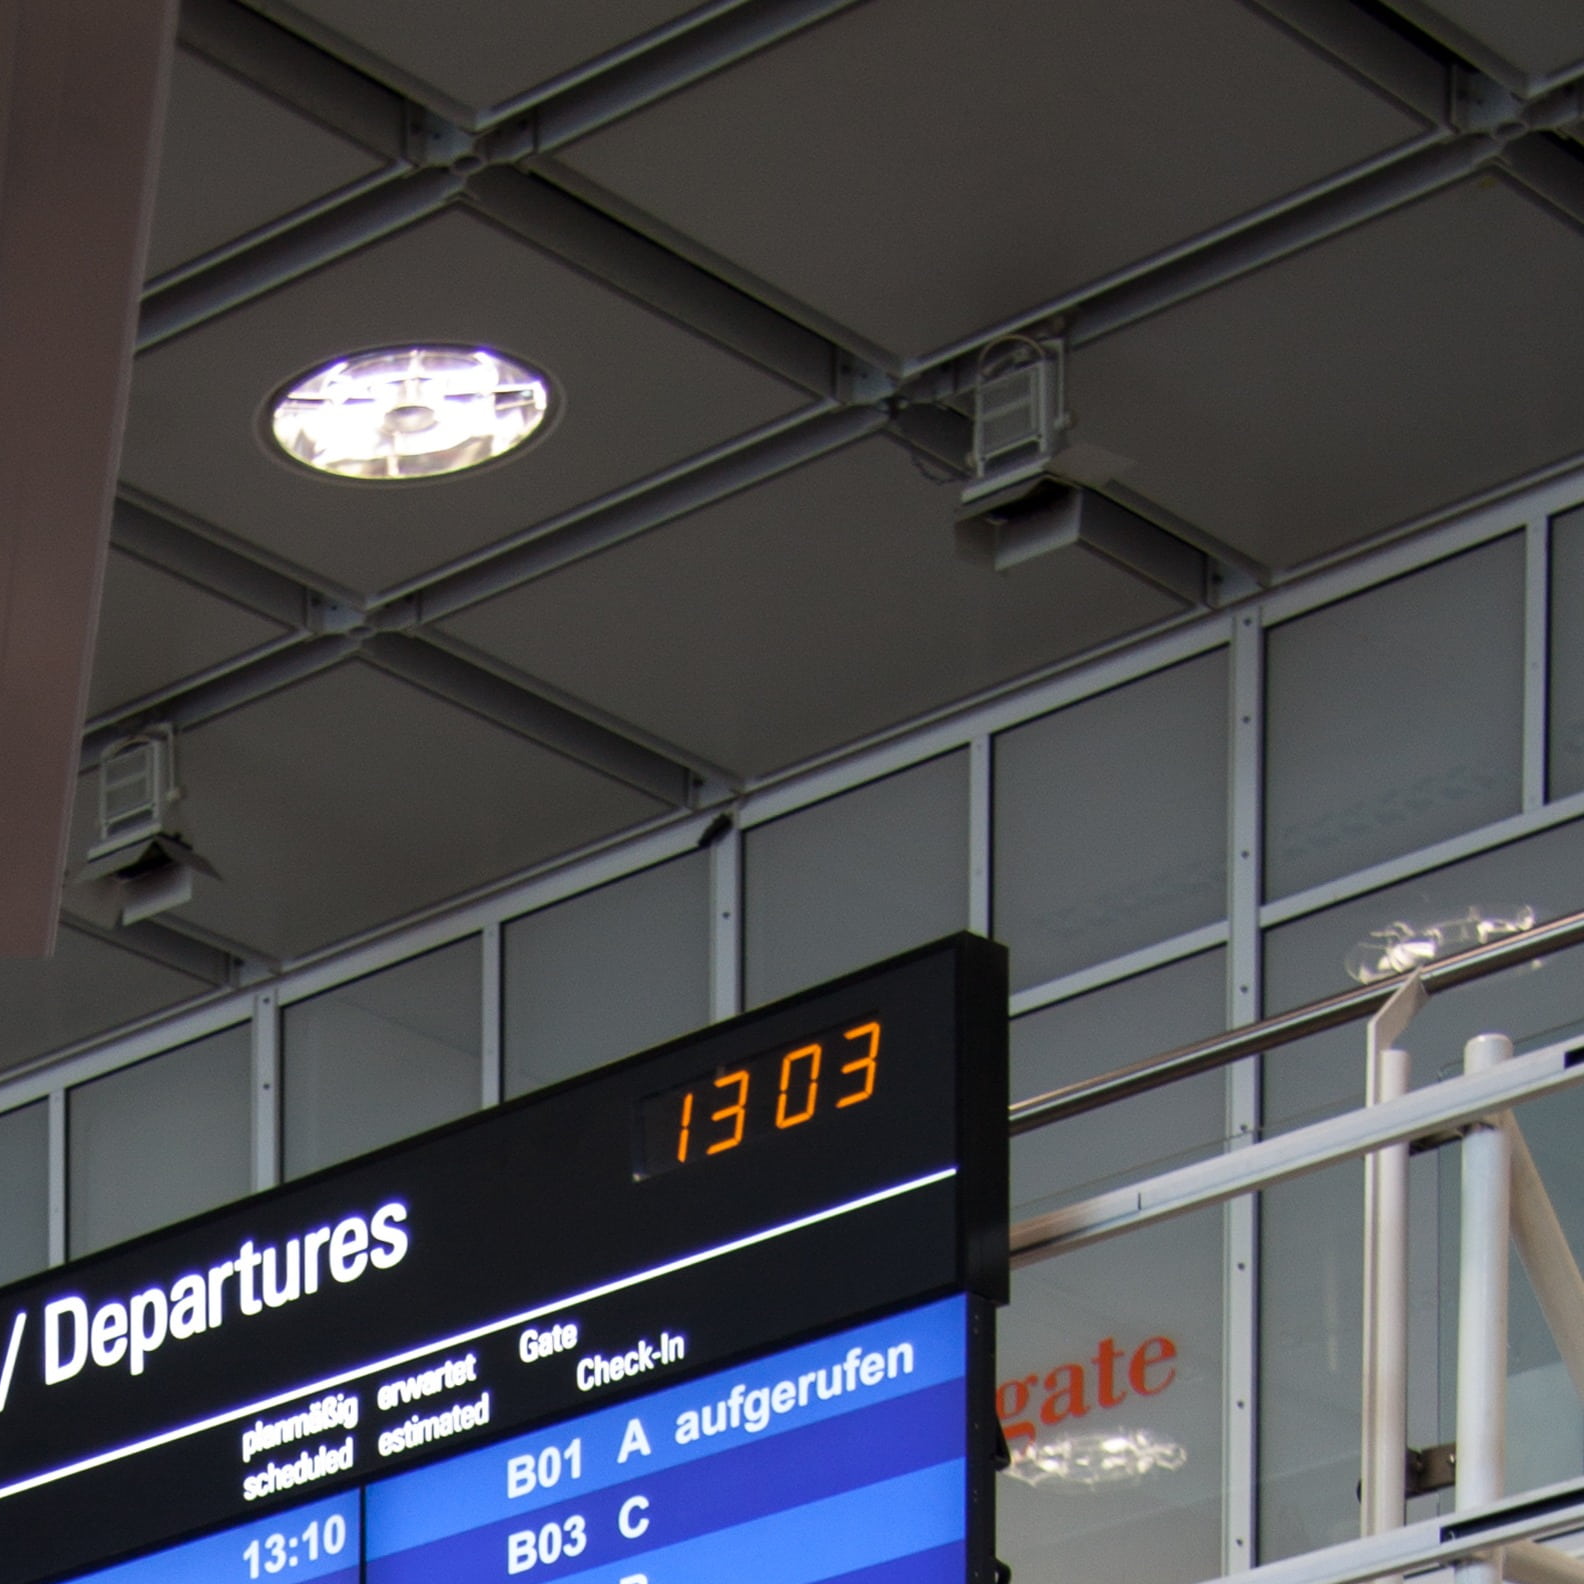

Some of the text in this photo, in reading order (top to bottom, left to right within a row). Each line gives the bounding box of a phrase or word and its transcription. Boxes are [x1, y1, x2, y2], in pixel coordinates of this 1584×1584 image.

[44, 1202, 408, 1386] Departures
[519, 1324, 578, 1363] Gate
[242, 1353, 477, 1463] planmäßig erwartet
[576, 1332, 685, 1391] Check-In
[243, 1392, 490, 1501] scheduled estimated
[243, 1515, 346, 1579] 13:10
[507, 1438, 581, 1499] B01
[617, 1418, 651, 1463] A
[675, 1343, 914, 1444] aufgerufen
[508, 1515, 587, 1574] B03
[619, 1495, 649, 1539] C
